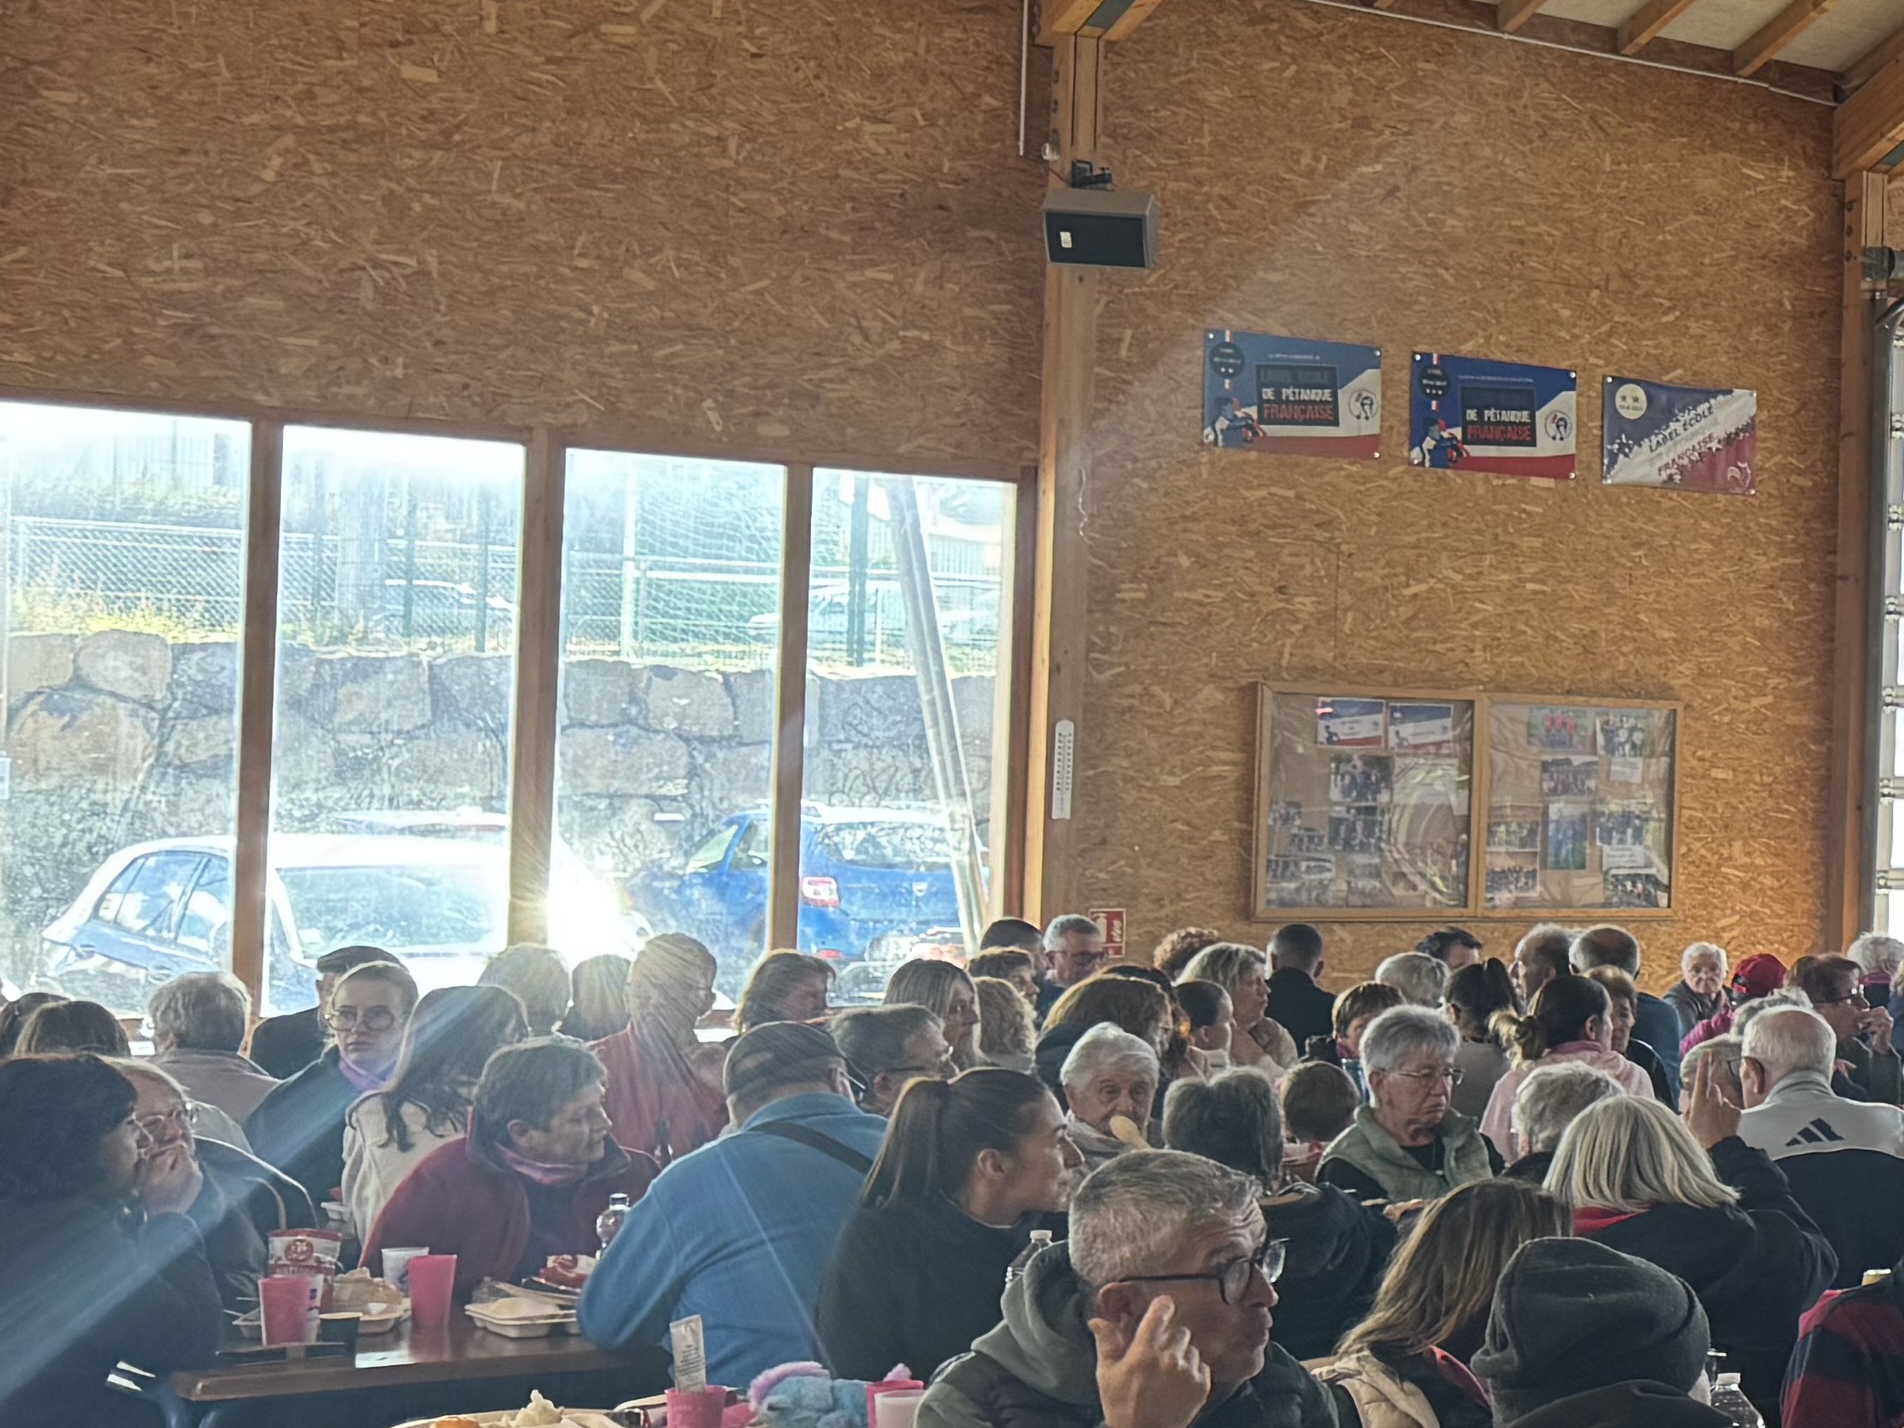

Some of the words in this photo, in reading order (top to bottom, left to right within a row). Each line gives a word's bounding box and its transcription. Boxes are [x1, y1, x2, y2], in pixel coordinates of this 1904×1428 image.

[1262, 388, 1275, 400] DE
[1281, 386, 1333, 402] PÉTANQUE
[1263, 404, 1334, 421] FRANÇAISE
[1466, 408, 1478, 421] DE
[1484, 407, 1531, 423] PÉTANQUE
[1467, 425, 1532, 442] FRANÇAISE
[1649, 428, 1681, 453] LABEL
